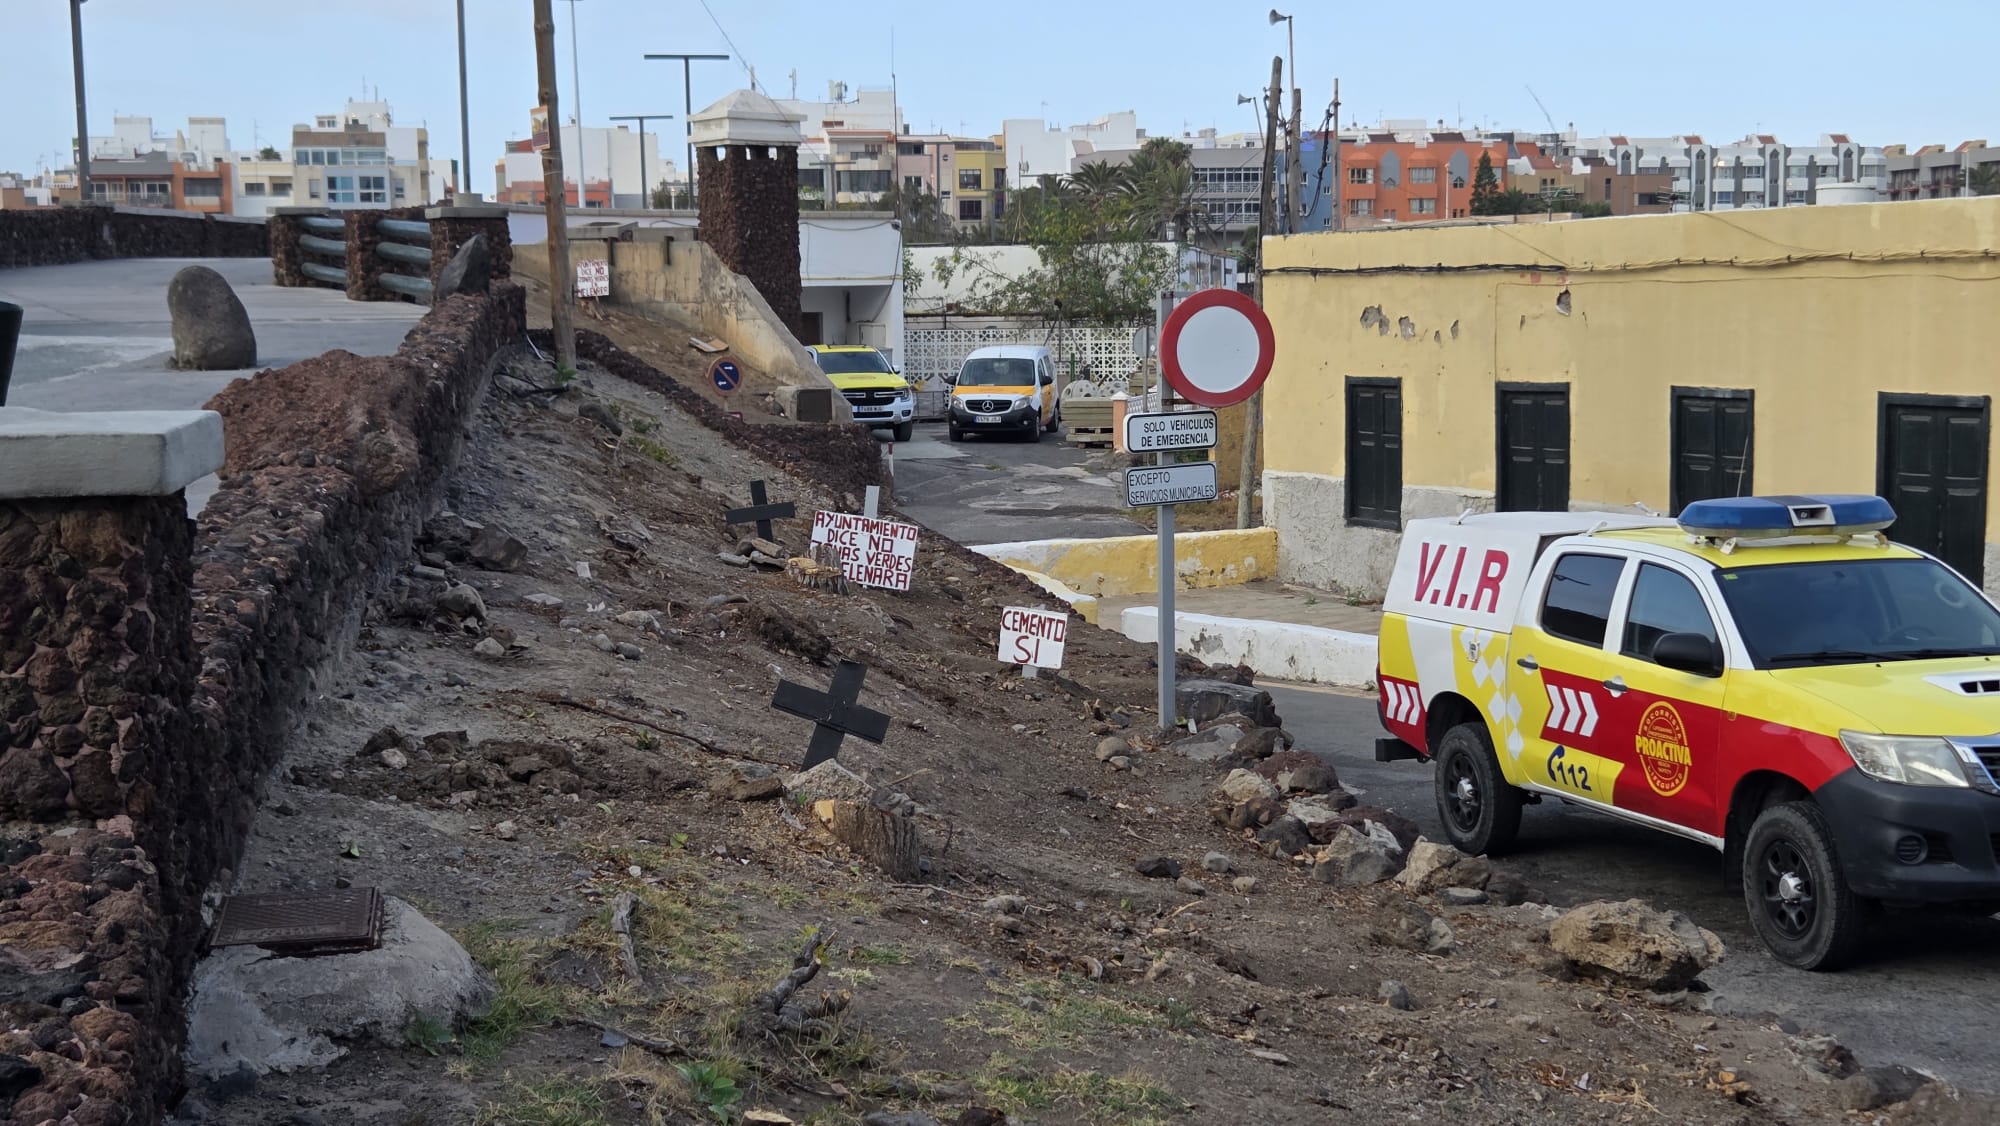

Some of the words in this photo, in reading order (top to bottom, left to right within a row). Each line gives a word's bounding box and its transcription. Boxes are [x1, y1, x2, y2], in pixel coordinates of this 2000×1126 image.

[1144, 421, 1165, 433] SOLO
[1170, 418, 1214, 431] VEHICULOS
[1141, 436, 1152, 447] DE
[1157, 433, 1208, 446] EMERGENCIA
[1129, 471, 1170, 486] EXCEPTO
[1131, 489, 1168, 503] SERVICIOS
[1170, 485, 1214, 500] MUNICIPALES
[815, 511, 917, 541] AYUNTAMIENTO
[827, 528, 858, 546] DICE
[869, 535, 894, 553] NO
[842, 562, 908, 589] ELENARA
[866, 551, 912, 573] VERDES
[1414, 542, 1509, 613] V.I.R
[1002, 610, 1065, 642] CEMENTO
[1013, 635, 1040, 664] SI
[1635, 734, 1692, 766] PROACTIVA
[1557, 761, 1592, 791] 112
